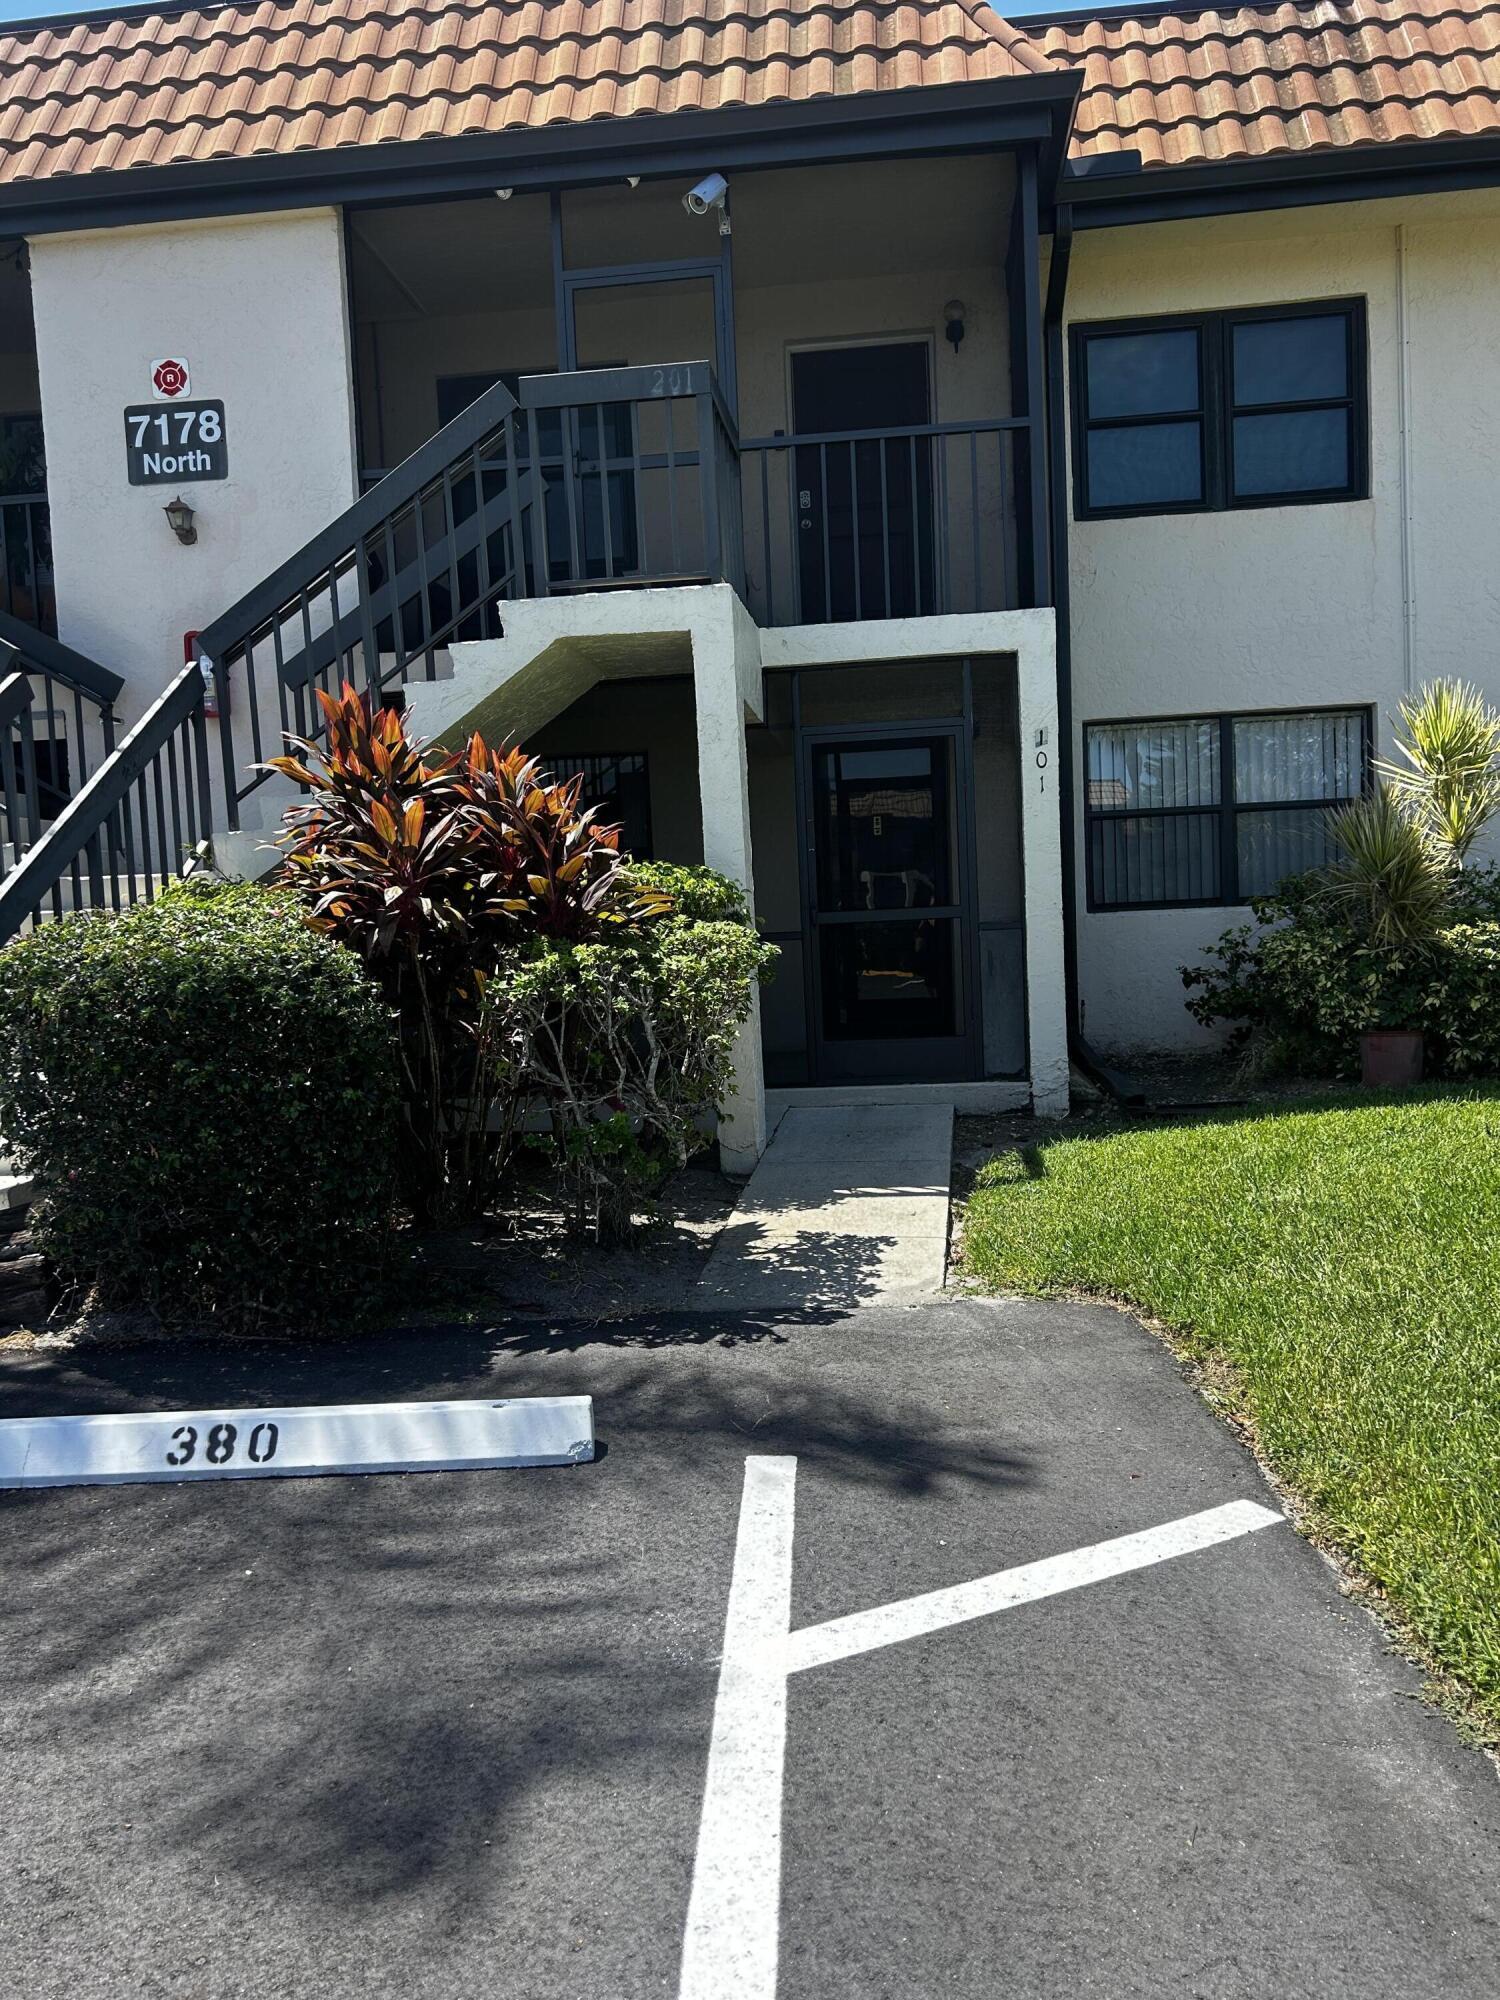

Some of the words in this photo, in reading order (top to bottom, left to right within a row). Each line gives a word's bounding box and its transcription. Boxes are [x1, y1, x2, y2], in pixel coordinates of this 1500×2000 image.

[166, 374, 175, 383] R
[651, 366, 693, 396] 201
[128, 409, 222, 448] 7178
[143, 450, 212, 475] North
[1035, 729, 1048, 794] 101
[166, 1423, 279, 1466] 380
